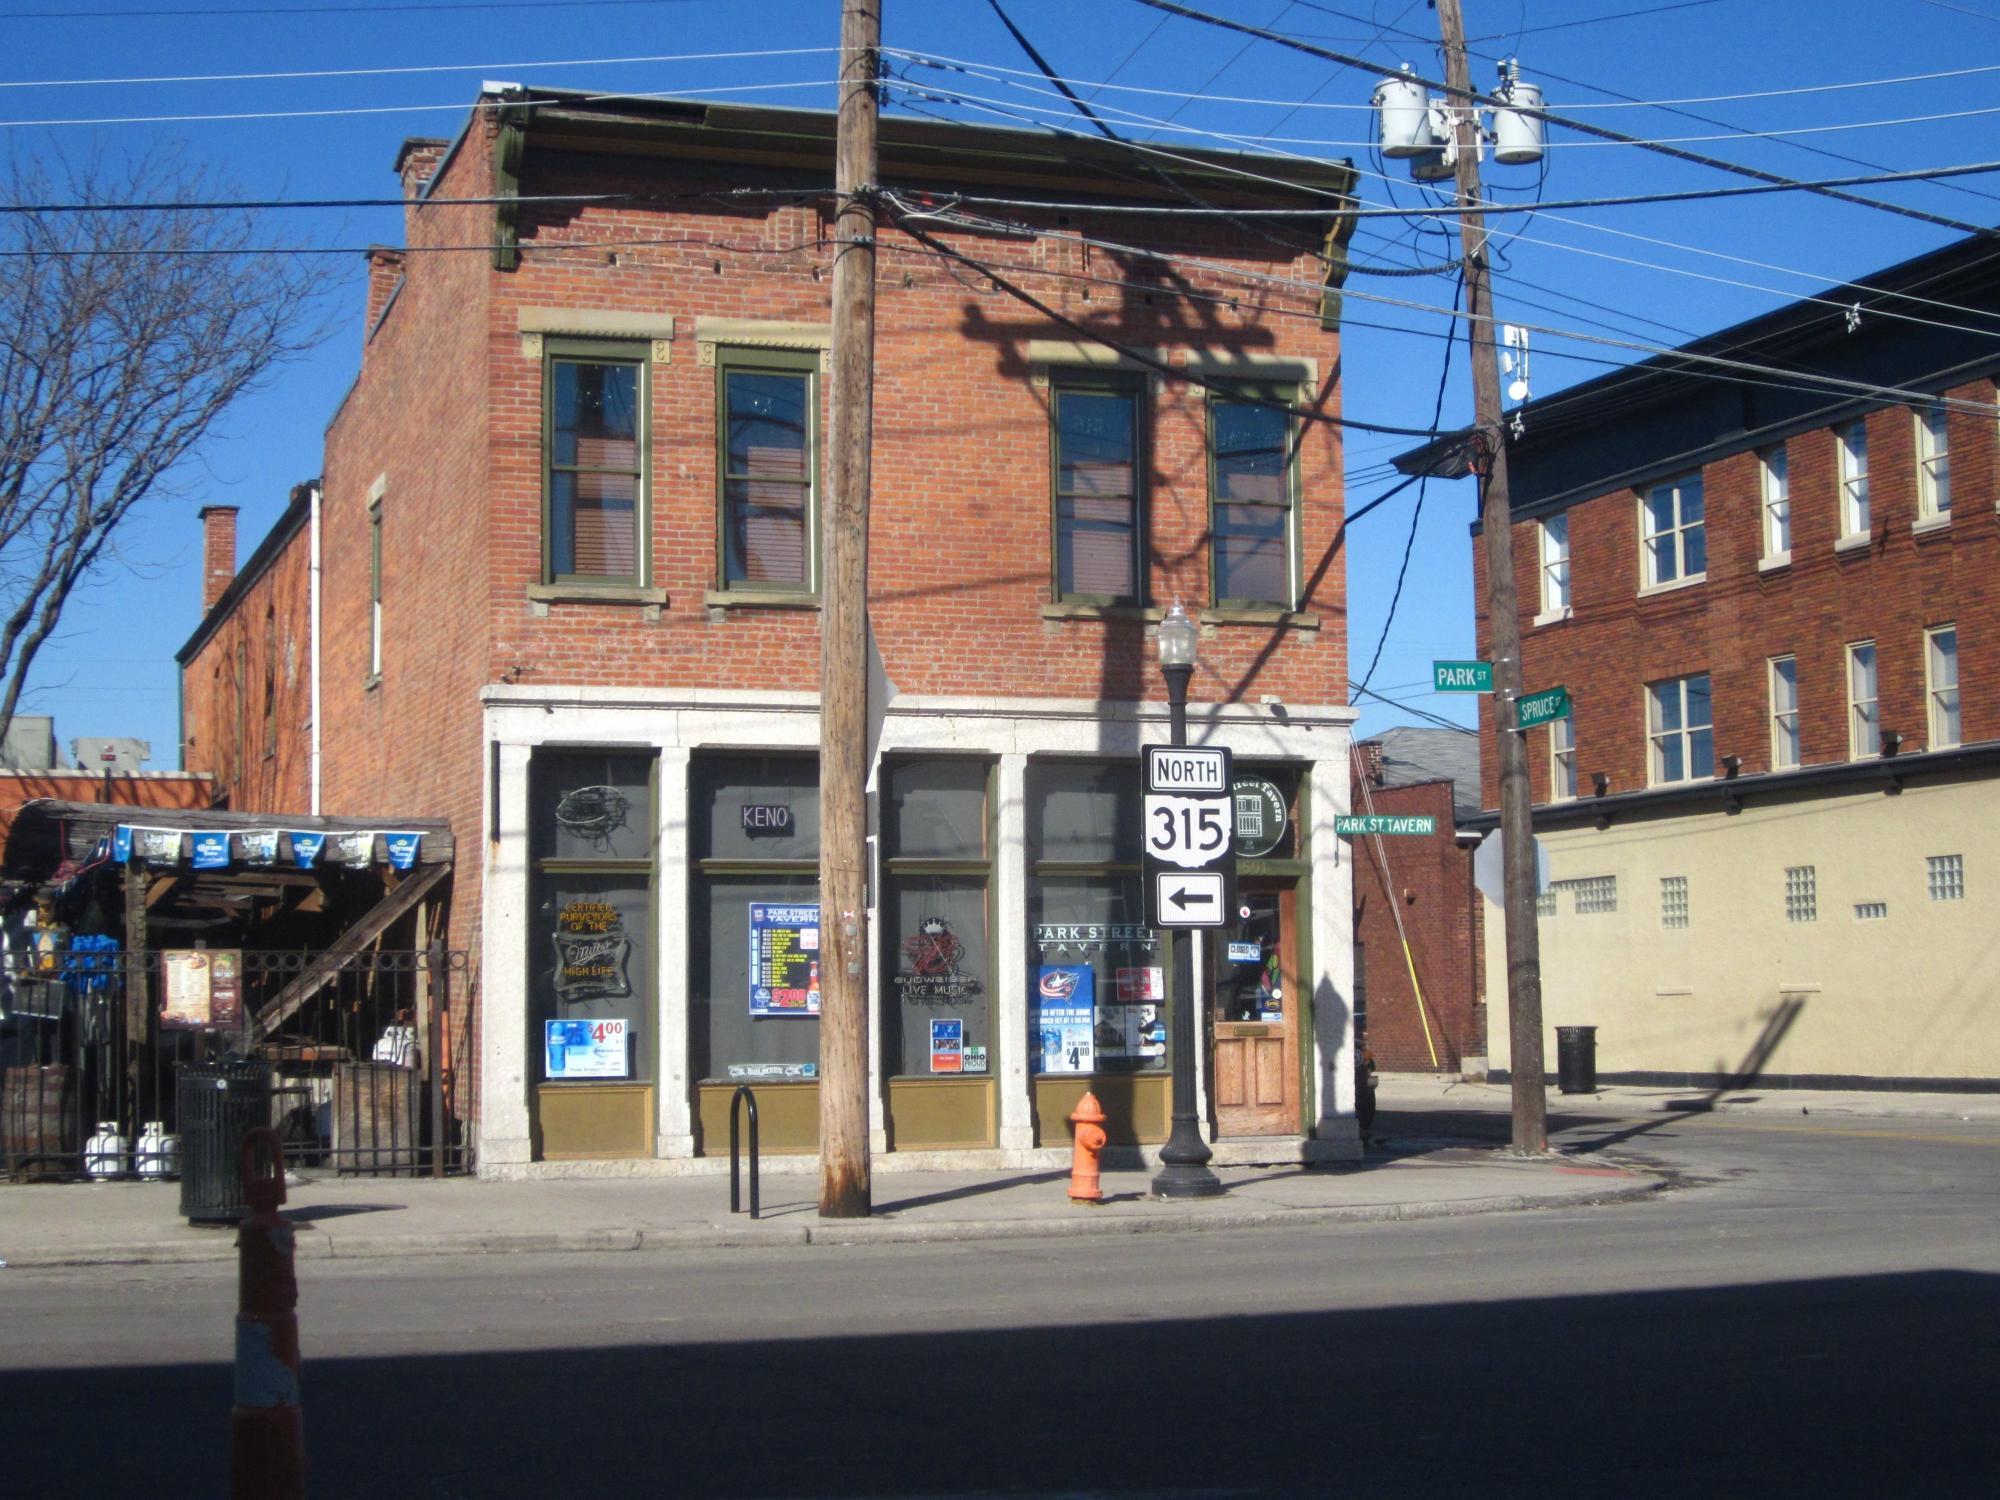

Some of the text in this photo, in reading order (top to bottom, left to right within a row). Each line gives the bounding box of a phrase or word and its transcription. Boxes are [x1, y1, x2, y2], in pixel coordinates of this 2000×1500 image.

[1437, 668, 1487, 686] PARK ST
[1521, 696, 1562, 721] SPRUCE ST
[1157, 757, 1218, 783] NORTH
[1261, 782, 1283, 823] Tavern
[743, 807, 788, 827] KENO
[1151, 806, 1223, 851] 315
[1336, 818, 1367, 832] PARK
[1387, 818, 1432, 833] TAVERN
[565, 902, 614, 912] CERTIFIED
[560, 912, 618, 921] PURVEYORS
[789, 909, 818, 917] STREET
[570, 921, 608, 932] OF THE
[1032, 926, 1154, 939] PARK STREET
[1038, 943, 1152, 952] TAVERN
[1230, 944, 1250, 954] CLOSED
[564, 966, 614, 976] HIGH LIFE
[894, 976, 977, 984] BUDWEISER
[902, 985, 969, 995] LIVE MUSIC
